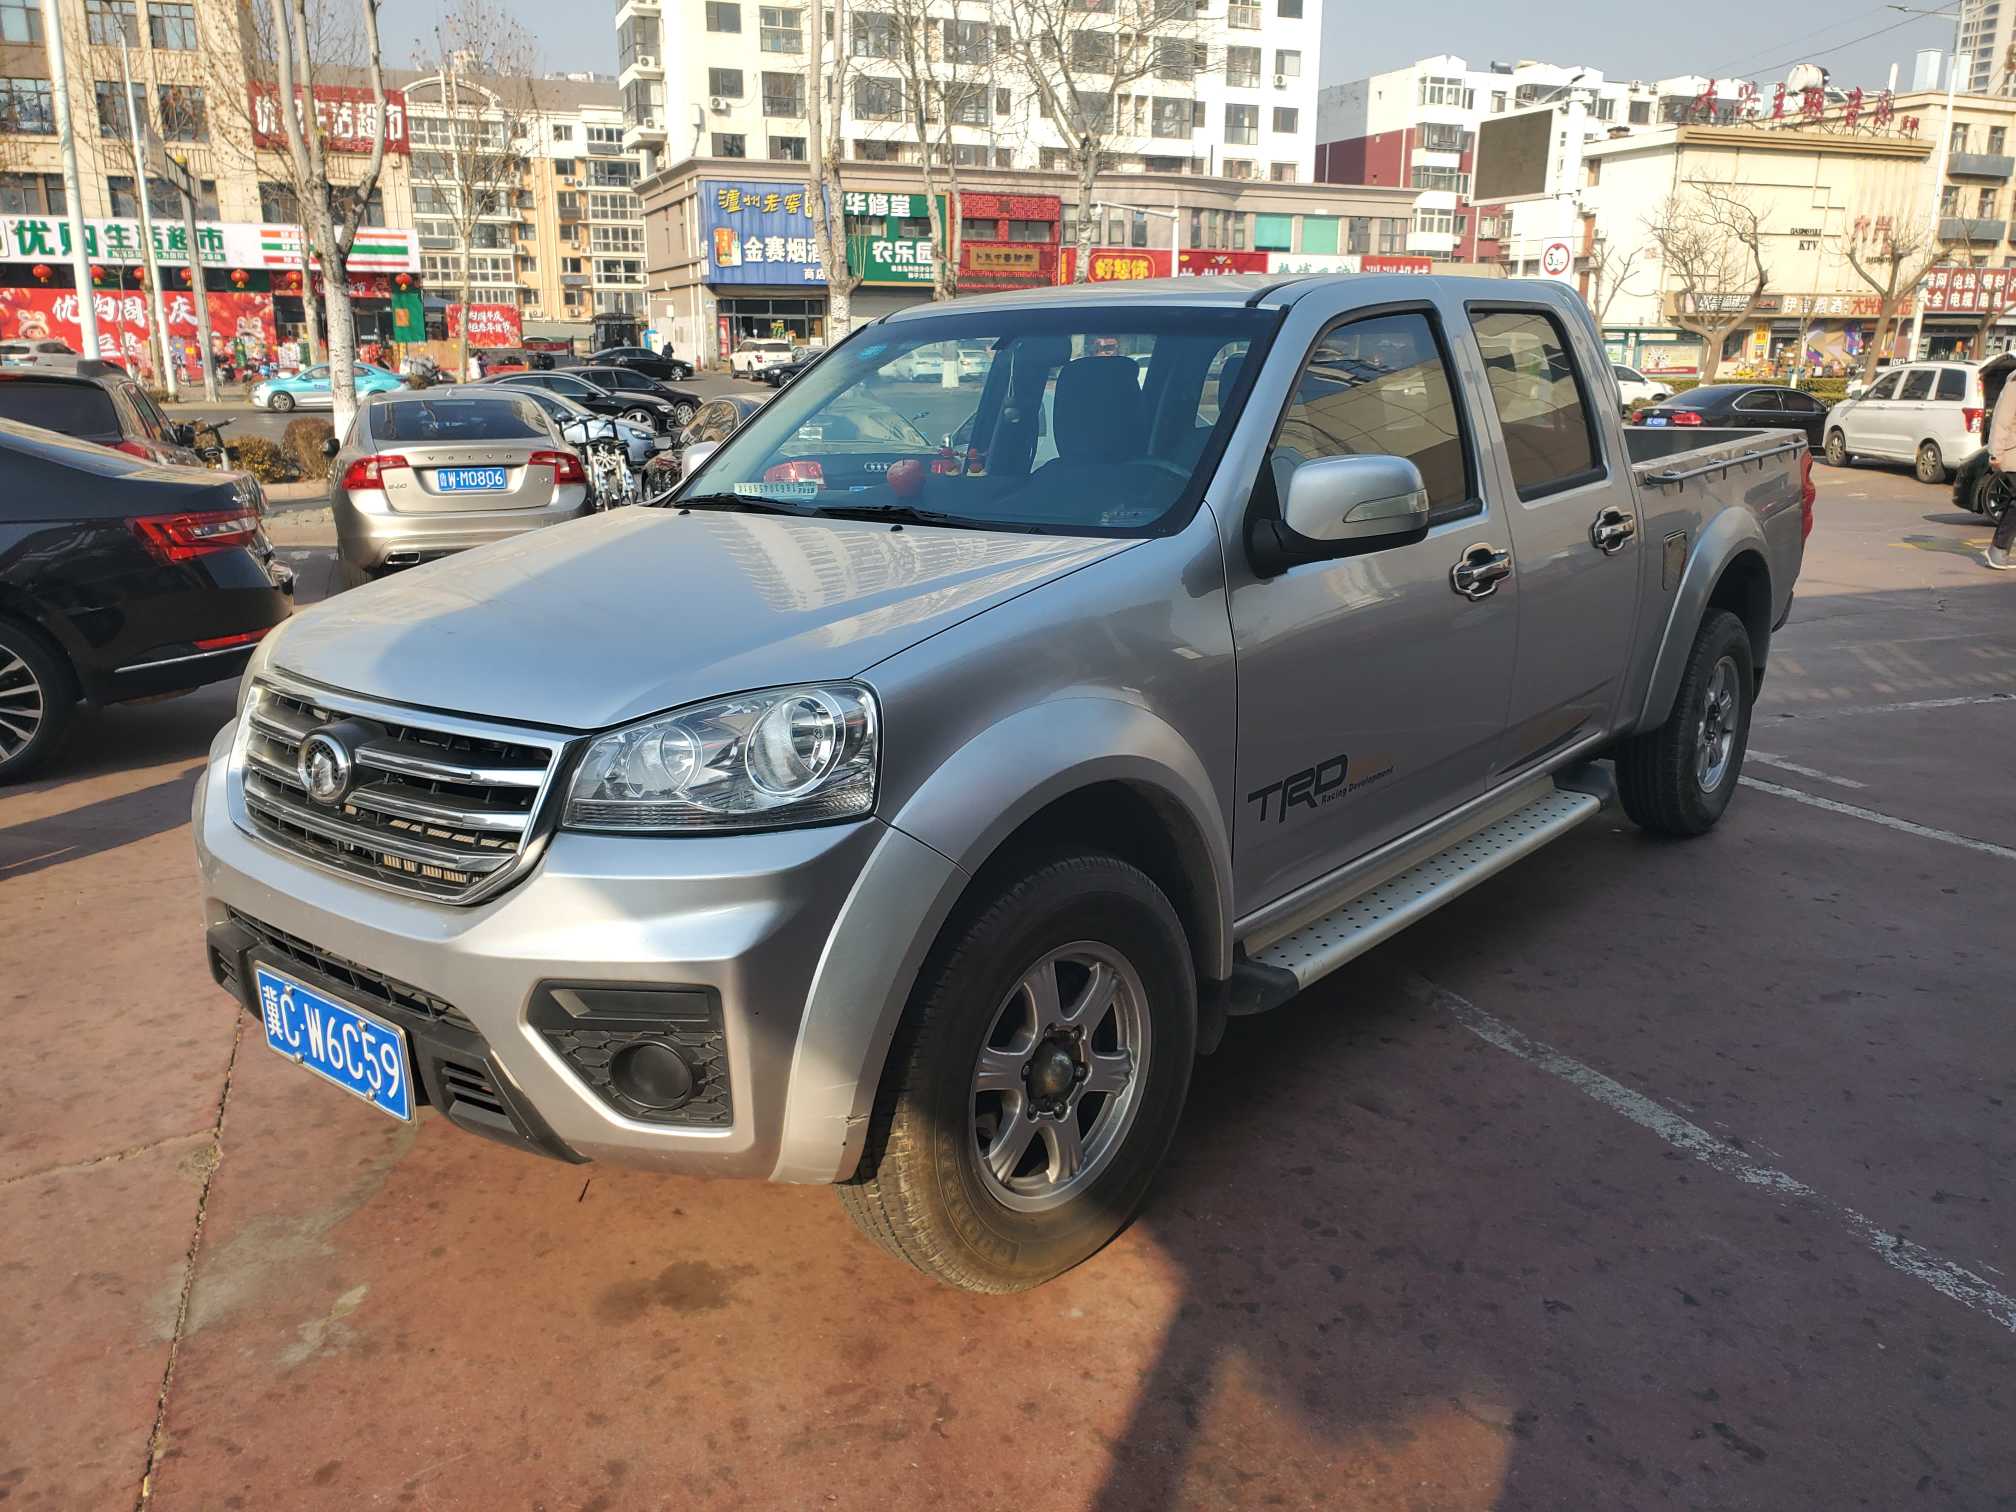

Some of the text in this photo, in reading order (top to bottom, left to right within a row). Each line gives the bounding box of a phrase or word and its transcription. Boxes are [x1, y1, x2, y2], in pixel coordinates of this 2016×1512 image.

[255, 95, 402, 141] 优生活超市
[845, 192, 911, 217] 华修堂
[872, 240, 934, 264] 农乐园
[1799, 240, 1819, 251] KTV
[1095, 258, 1149, 279] 好想你
[53, 294, 199, 328] 优购周庆
[427, 453, 513, 461] VOLVO
[1248, 754, 1348, 824] TRD
[1321, 788, 1347, 807] Racing
